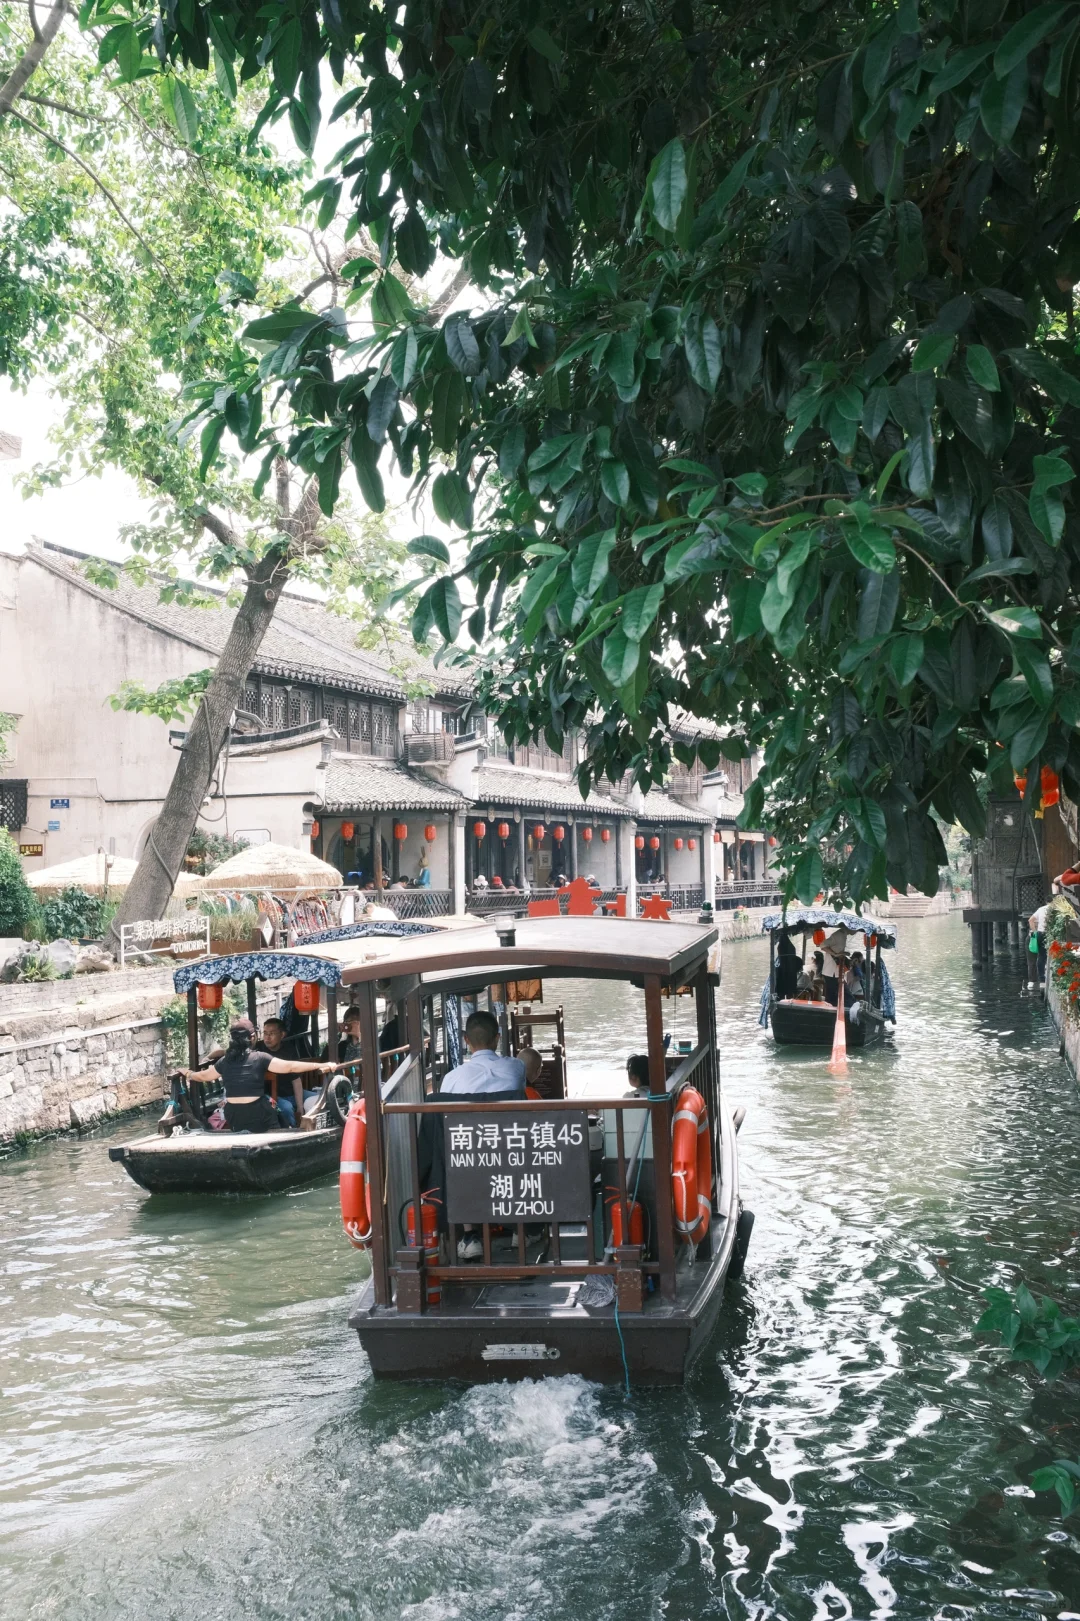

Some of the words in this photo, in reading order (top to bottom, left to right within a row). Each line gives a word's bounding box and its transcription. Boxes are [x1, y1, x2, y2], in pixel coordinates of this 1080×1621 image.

[449, 1121, 583, 1151] 南浔古镇45
[450, 1153, 474, 1167] NAN
[477, 1152, 502, 1167] XUN
[508, 1152, 525, 1166] GU
[531, 1151, 562, 1166] ZHEN
[489, 1173, 543, 1199] 湖州
[492, 1201, 512, 1216] HU
[515, 1200, 554, 1216] ZHOU
